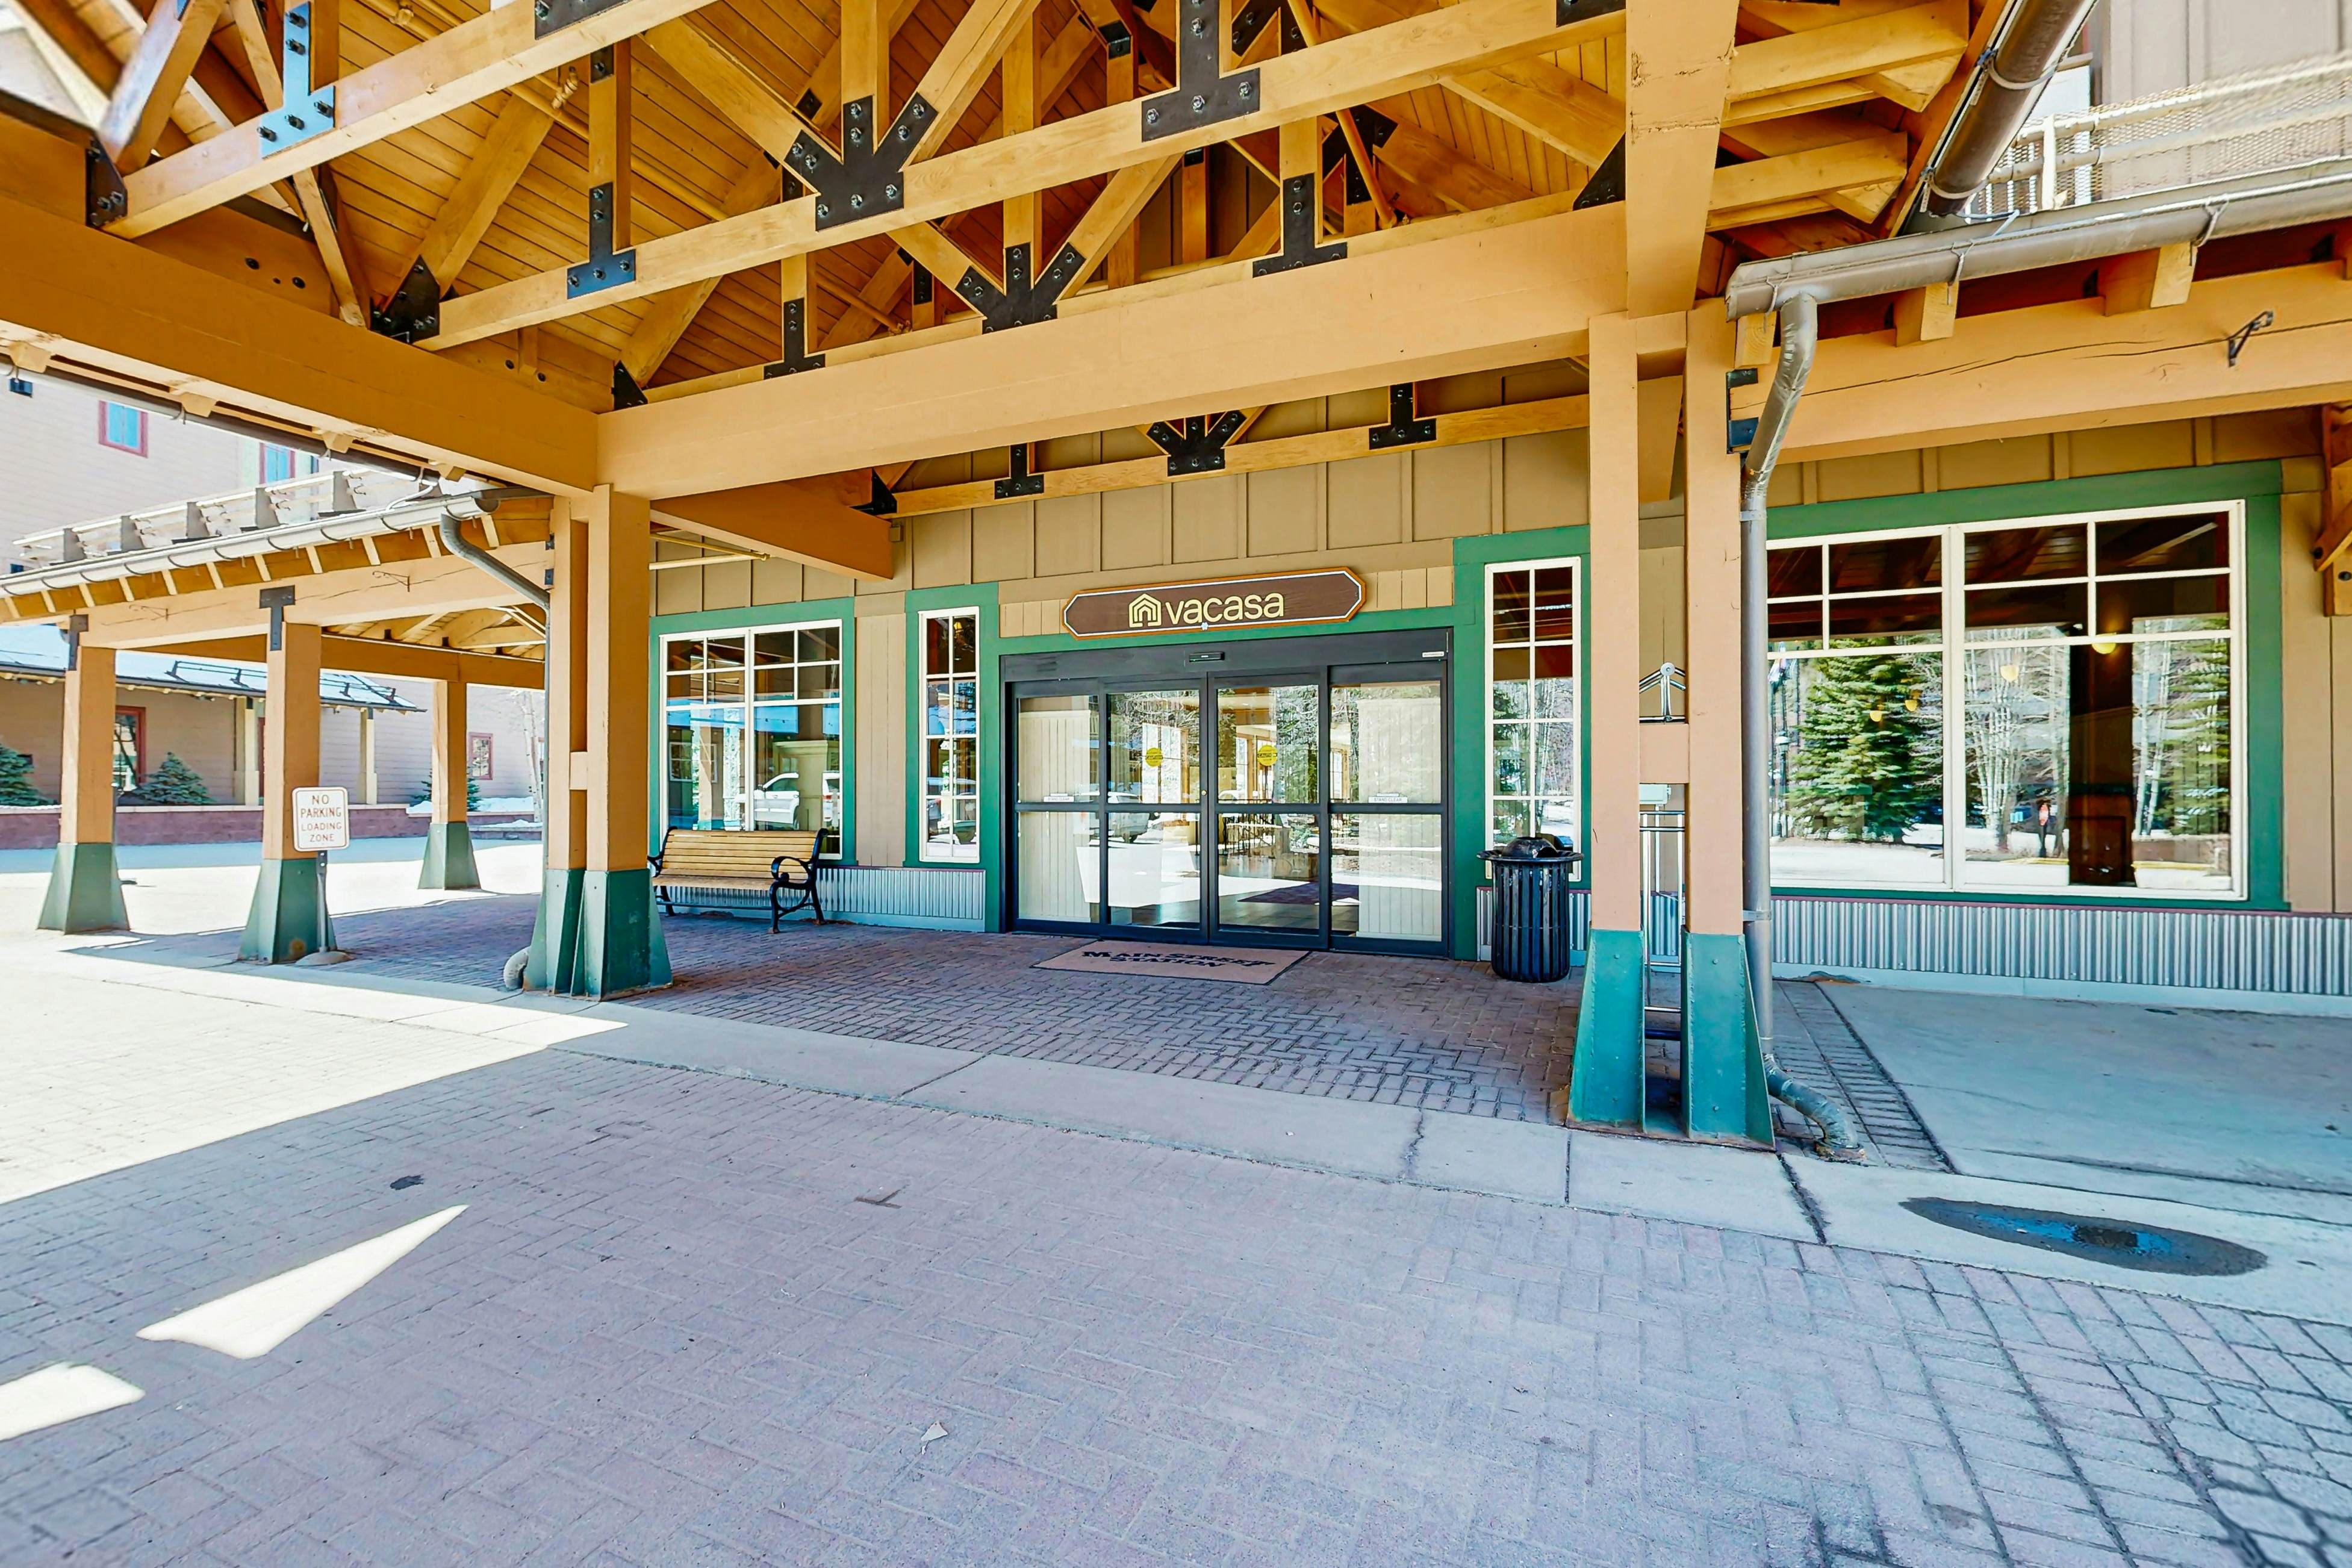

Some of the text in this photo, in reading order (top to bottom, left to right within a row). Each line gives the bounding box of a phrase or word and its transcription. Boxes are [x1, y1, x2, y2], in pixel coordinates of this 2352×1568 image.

[1165, 593, 1284, 624] vacasa
[312, 794, 330, 804] NO
[300, 807, 342, 818] PARKING
[301, 822, 342, 832] LOADING
[310, 834, 335, 842] ZONE
[1109, 957, 1225, 967] STATION
[1165, 953, 1275, 966] STREET
